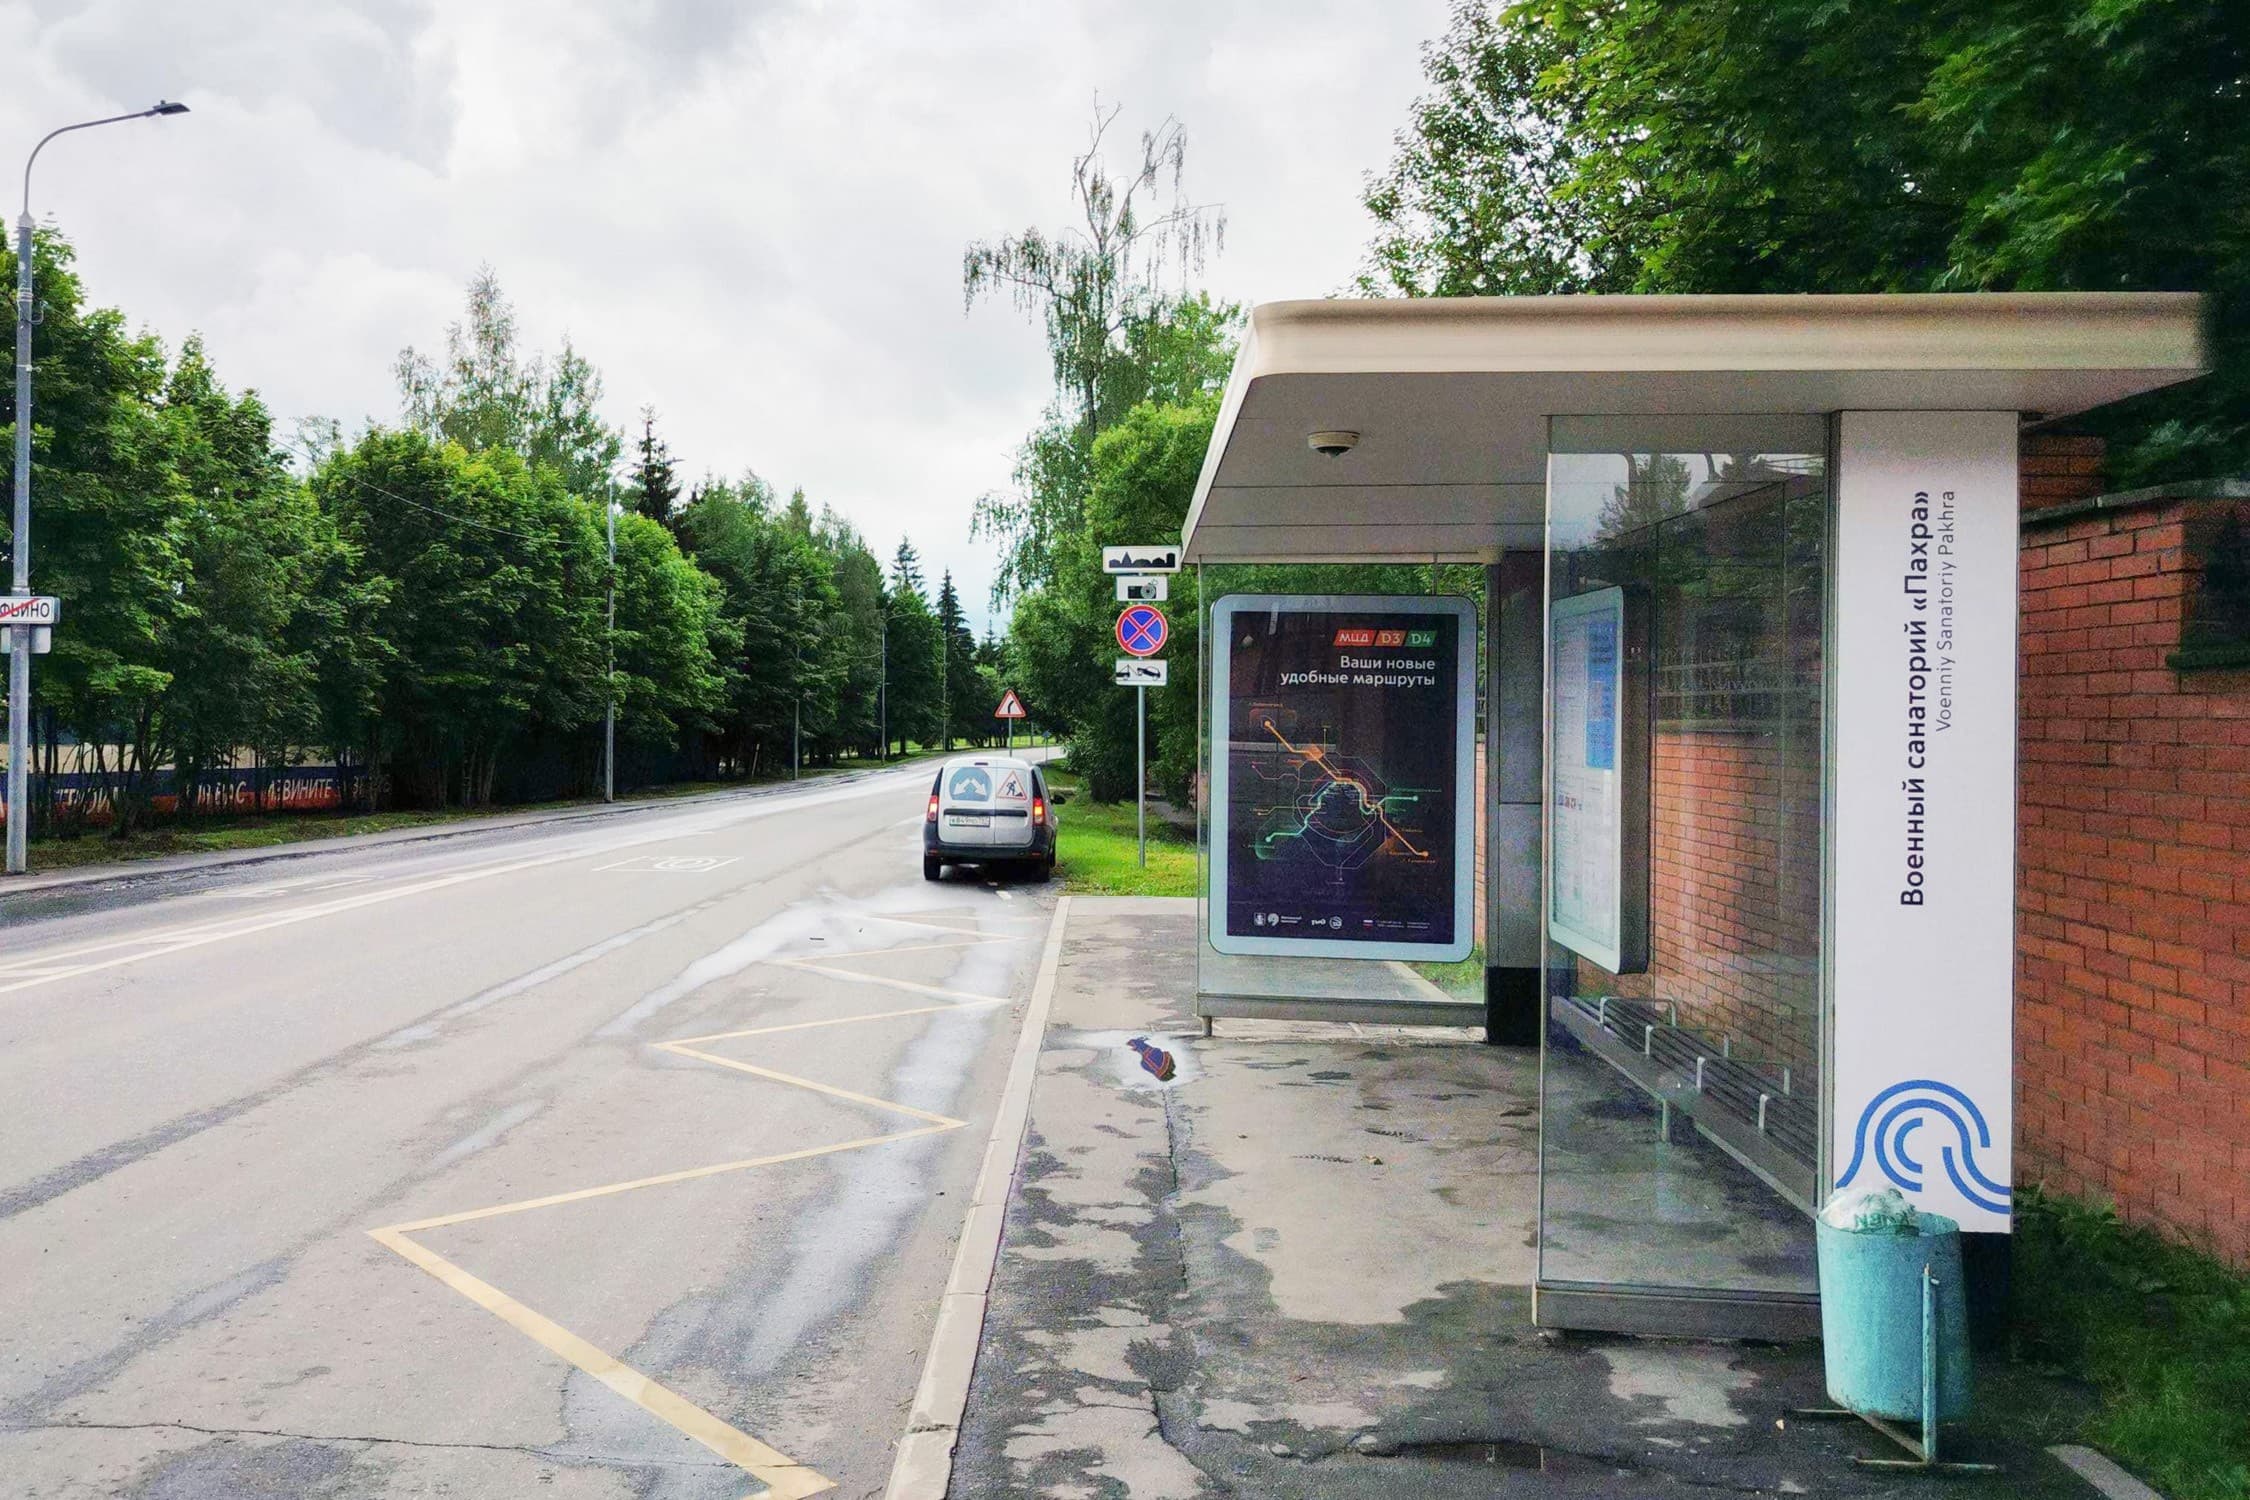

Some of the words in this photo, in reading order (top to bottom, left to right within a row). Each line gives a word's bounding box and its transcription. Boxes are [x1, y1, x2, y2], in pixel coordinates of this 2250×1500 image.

[1904, 491, 1934, 611] «Пахра»
[1937, 491, 1955, 555] Pakhra
[1339, 632, 1369, 643] МЦД
[1381, 633, 1401, 644] D3
[1411, 633, 1431, 645] D4
[1937, 561, 1957, 650] Sanatoriy
[1280, 670, 1349, 685] удобные
[1353, 674, 1435, 688] маршруты
[1340, 655, 1382, 669] Ваши
[1386, 659, 1436, 670] новые
[1904, 620, 1932, 769] санаторий
[1936, 656, 1956, 732] Voenniy
[1900, 778, 1925, 906] Военный
